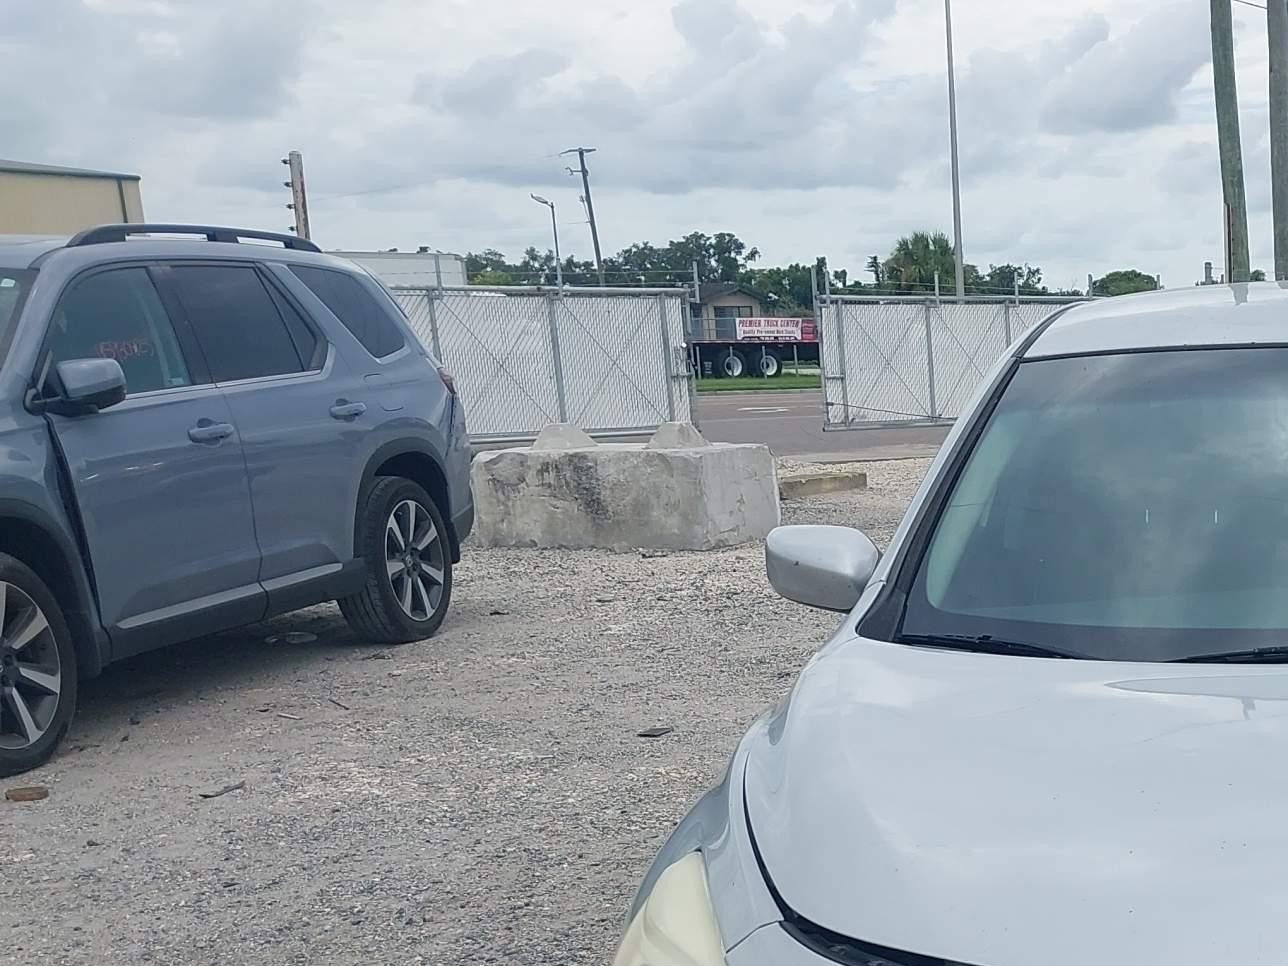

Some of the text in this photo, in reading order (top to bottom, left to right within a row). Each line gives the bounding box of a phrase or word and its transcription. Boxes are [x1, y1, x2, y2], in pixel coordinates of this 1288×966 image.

[738, 319, 801, 328] PREMIER TRUCK CENTER
